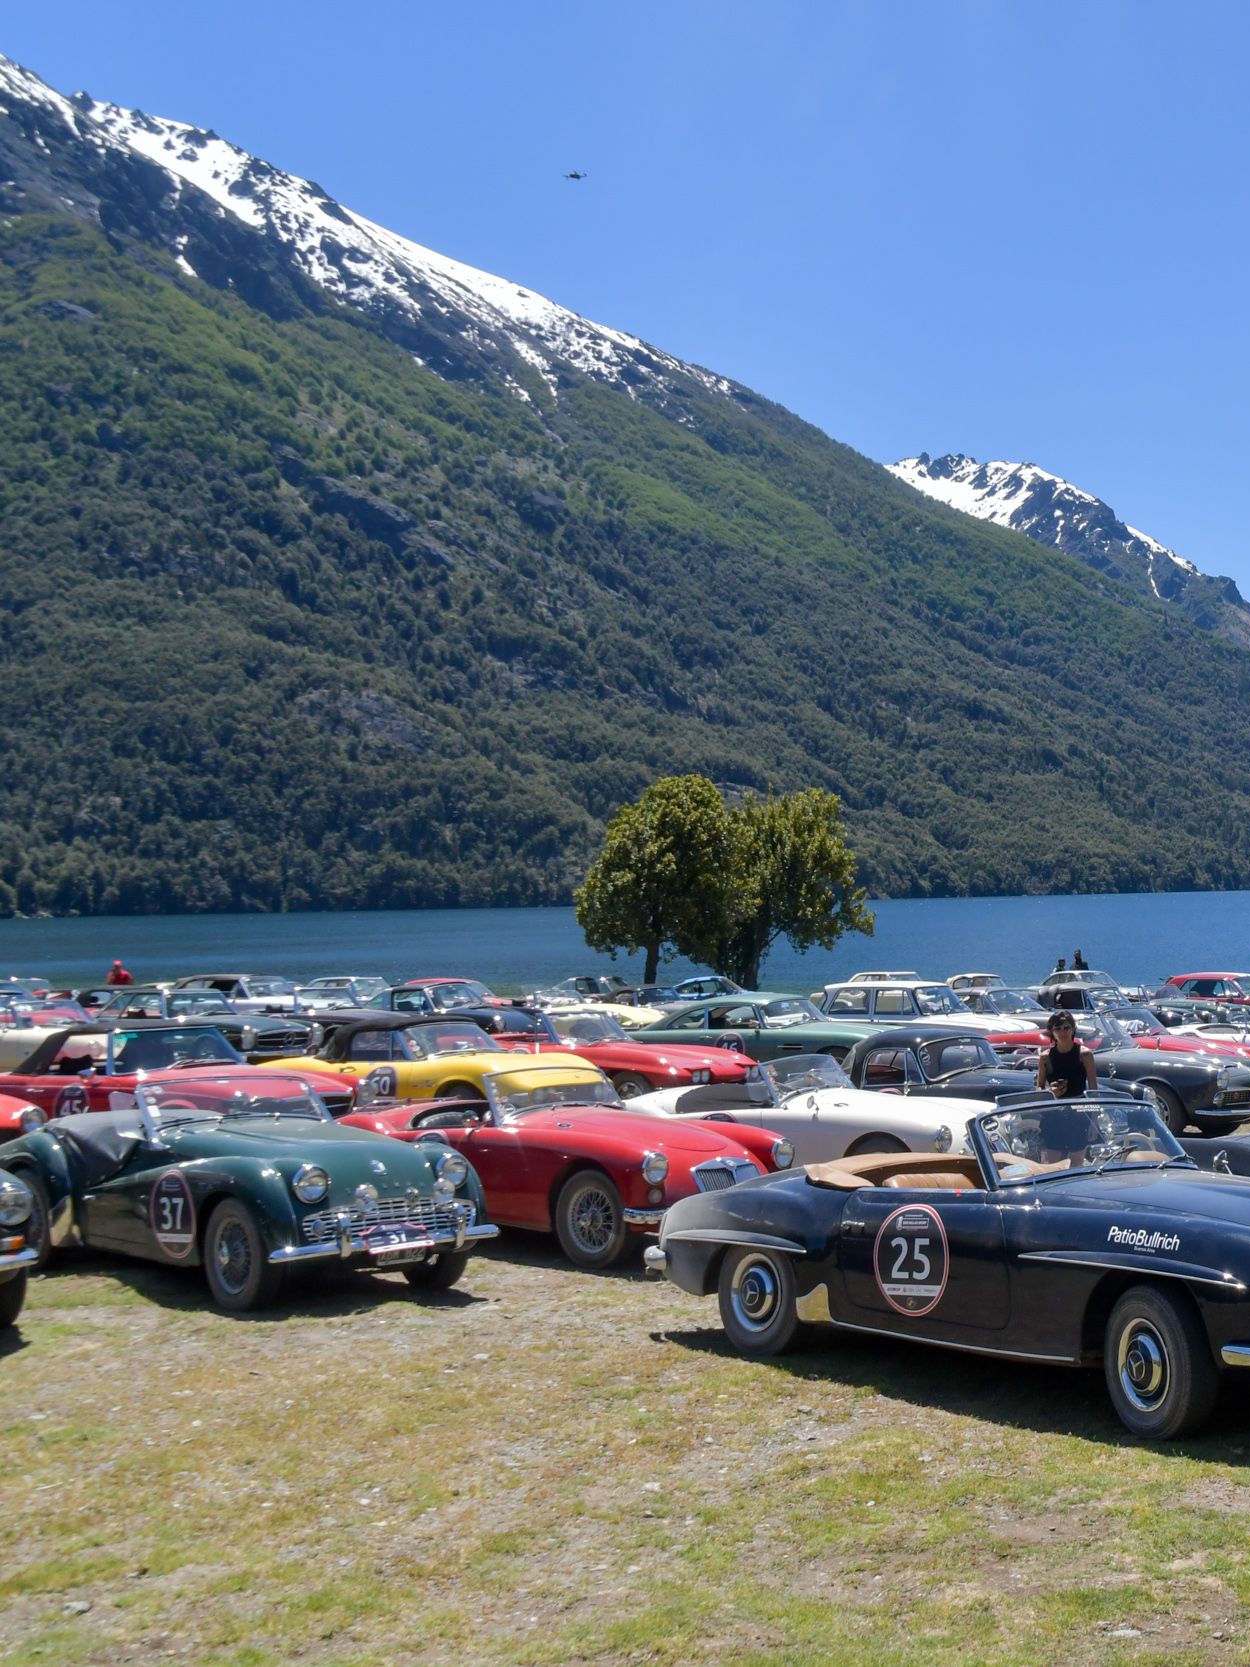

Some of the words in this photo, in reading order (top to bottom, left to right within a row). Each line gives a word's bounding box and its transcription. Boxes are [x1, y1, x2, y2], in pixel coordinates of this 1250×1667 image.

[160, 1197, 185, 1230] 37
[1107, 1226, 1180, 1251] PatioBullrich
[891, 1236, 931, 1281] 25
